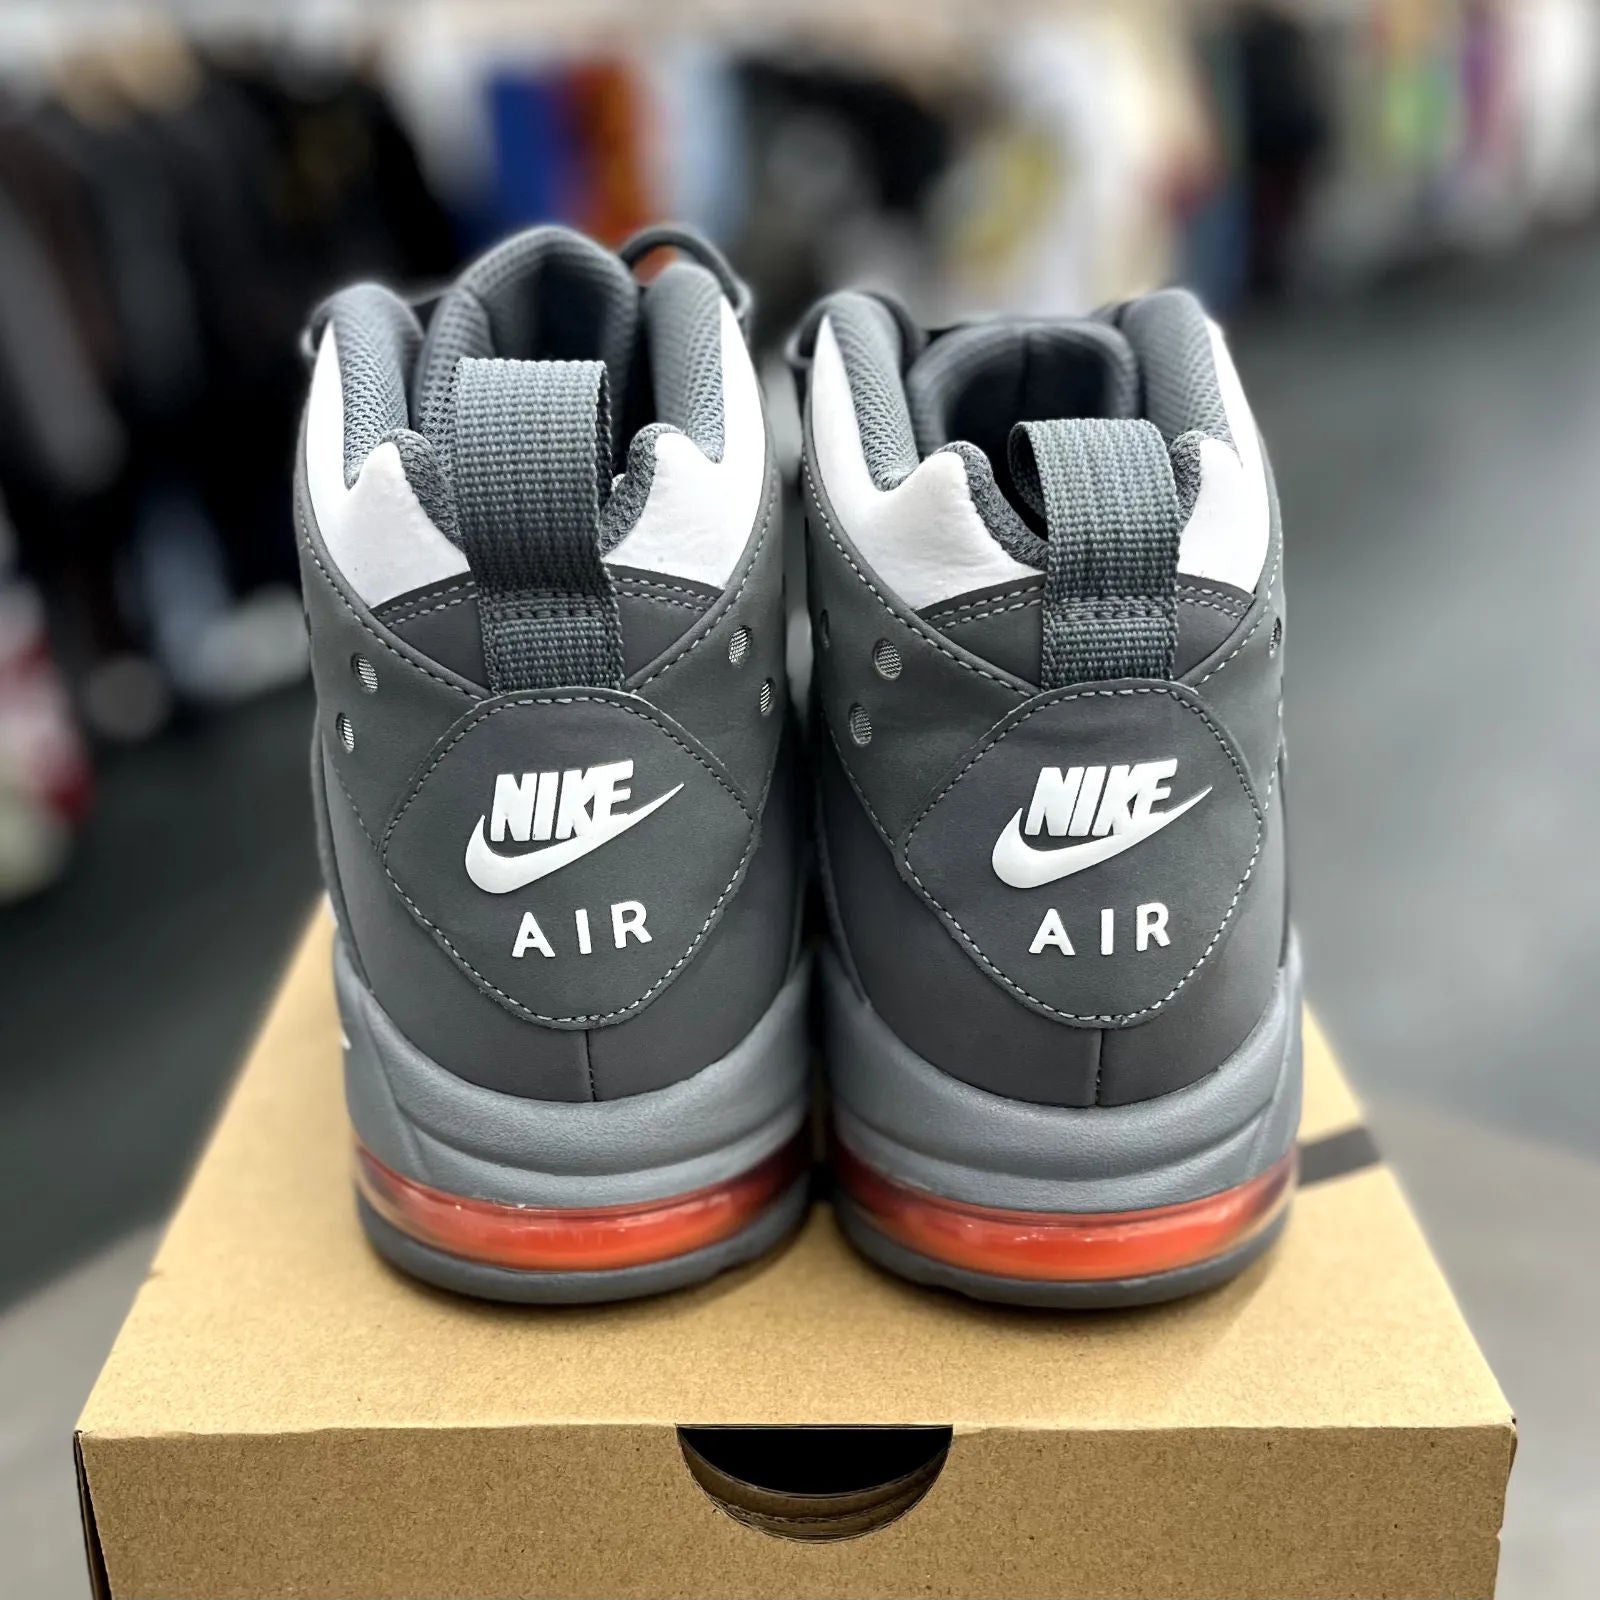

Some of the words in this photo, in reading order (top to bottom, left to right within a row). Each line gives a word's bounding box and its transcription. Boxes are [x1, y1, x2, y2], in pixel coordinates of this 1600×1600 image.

[490, 759, 634, 842] NIKE
[1024, 758, 1178, 837] NIKE
[511, 900, 653, 958] AIR
[1028, 902, 1171, 956] AIR
